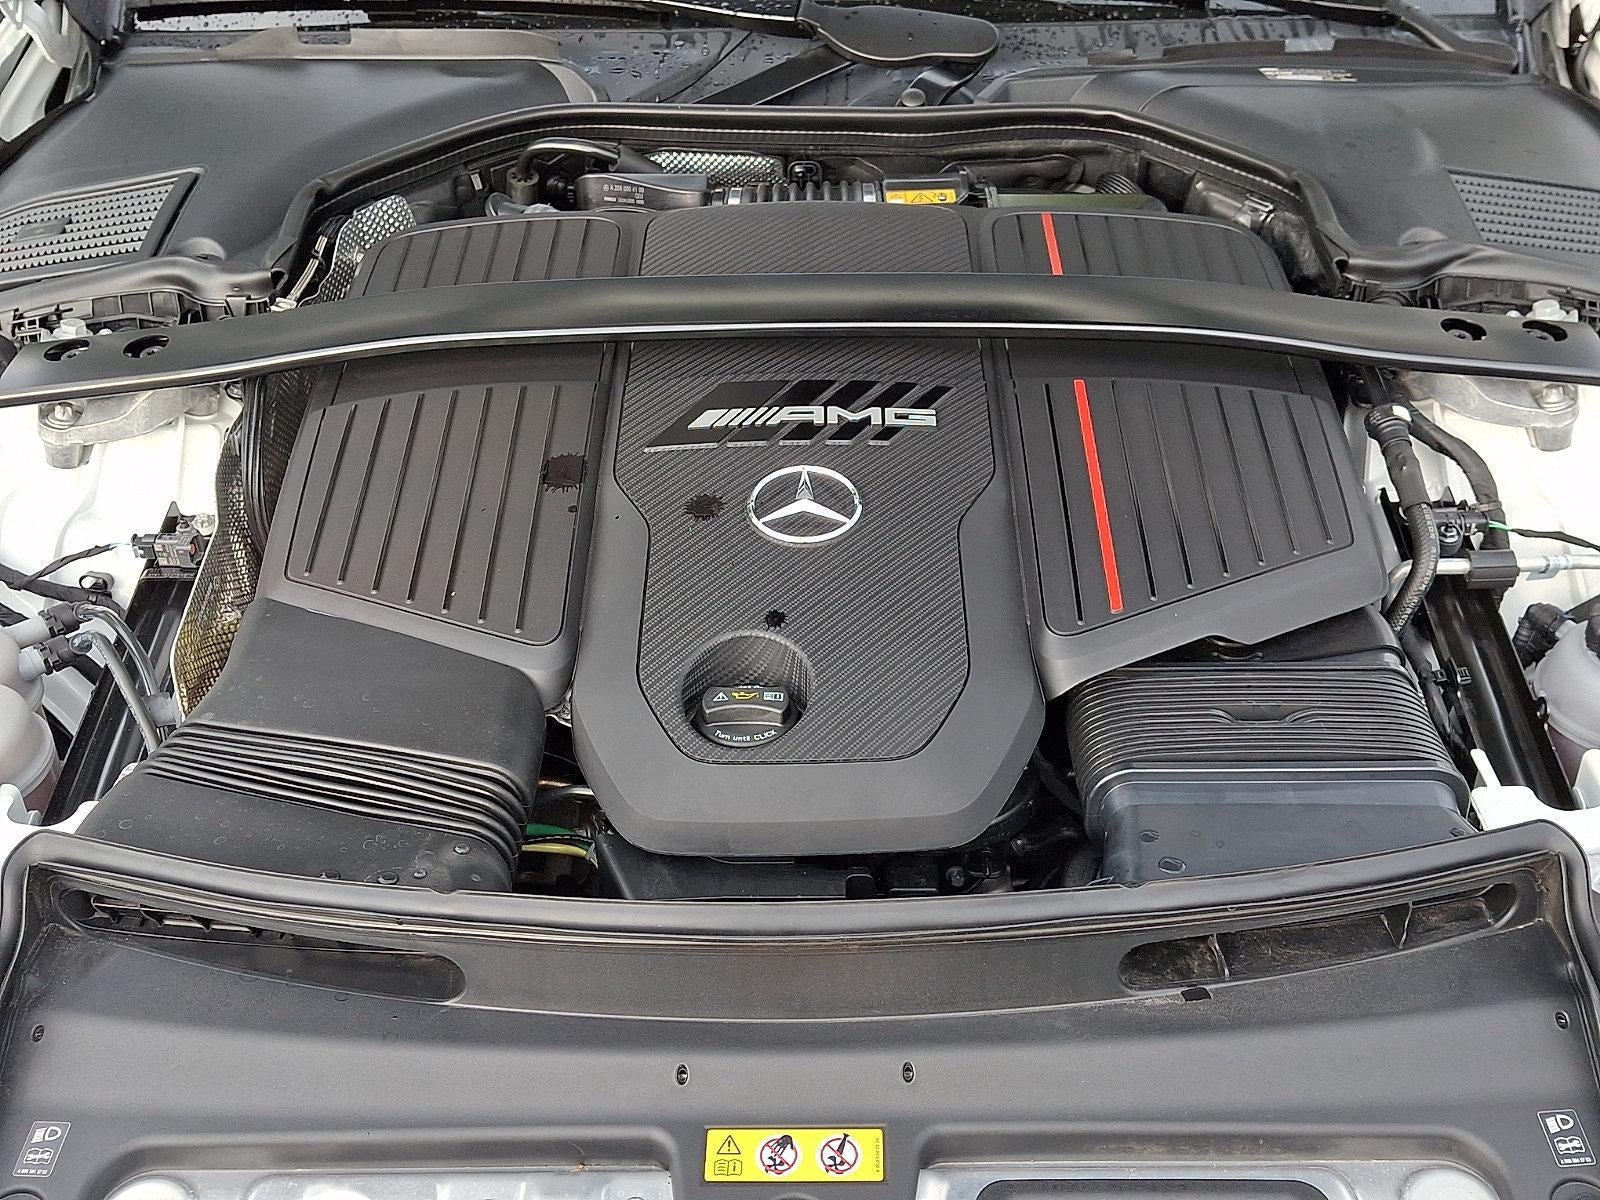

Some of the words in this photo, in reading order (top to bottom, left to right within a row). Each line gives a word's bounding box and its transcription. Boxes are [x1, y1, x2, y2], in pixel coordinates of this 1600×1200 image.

[765, 405, 937, 427] AMG
[714, 729, 731, 741] Turn
[732, 733, 751, 742] until
[753, 729, 778, 741] CLICK
